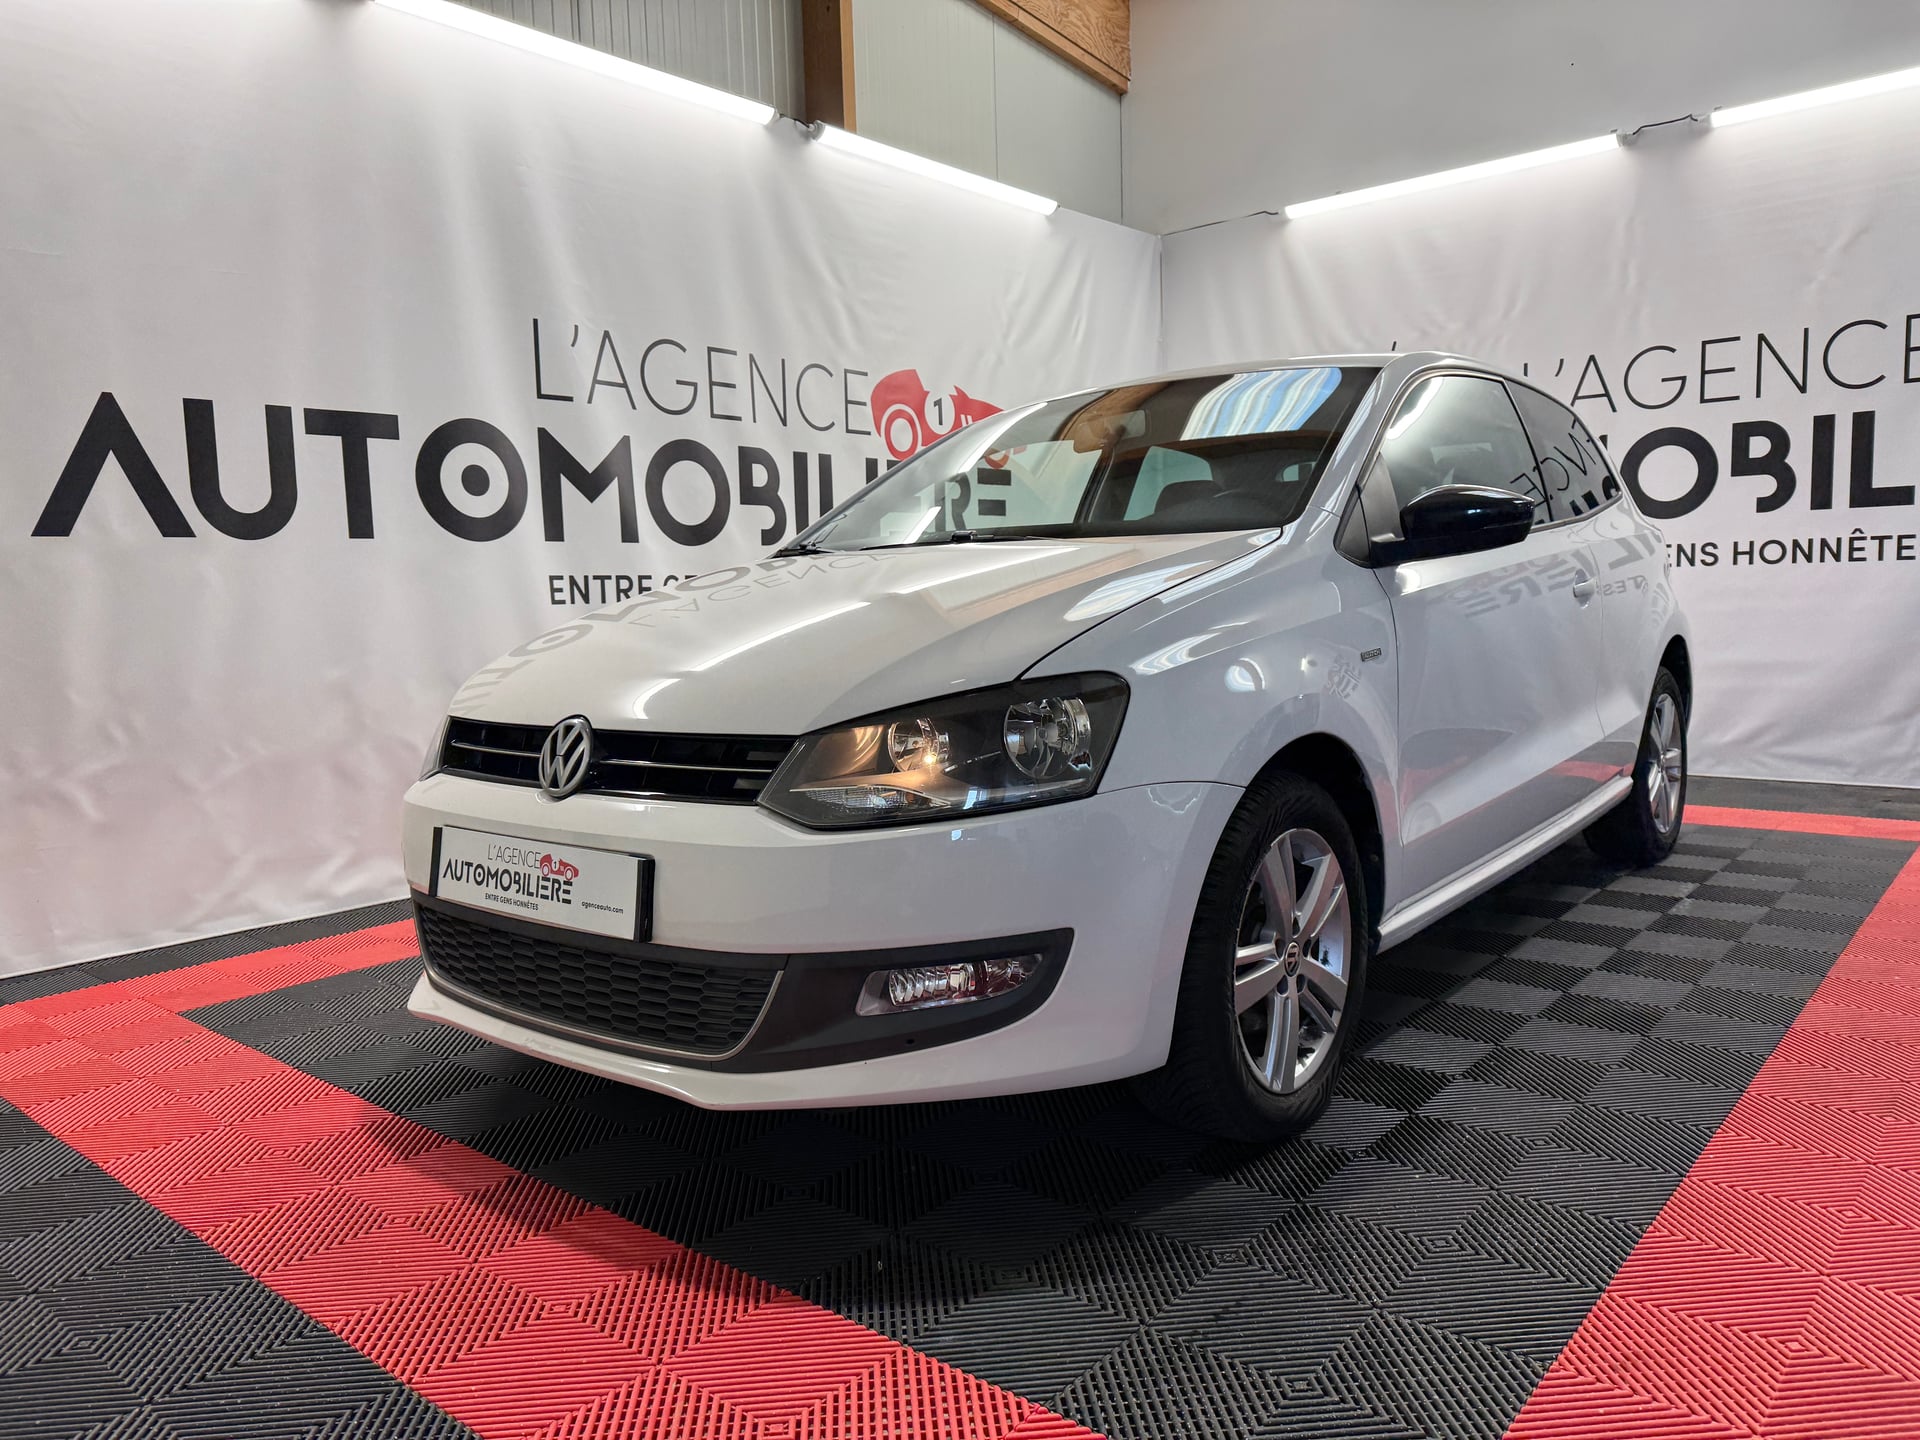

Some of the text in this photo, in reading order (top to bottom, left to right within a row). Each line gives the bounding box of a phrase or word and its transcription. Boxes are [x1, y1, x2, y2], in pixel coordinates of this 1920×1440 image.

[1523, 313, 1920, 413] 'AGENCE
[533, 318, 872, 436] L'AGENCE
[932, 398, 943, 426] 1
[487, 843, 542, 869] L'AGENCE
[484, 892, 500, 904] ENTRE
[499, 895, 513, 906] GENS
[581, 901, 624, 915] agenceauto.com
